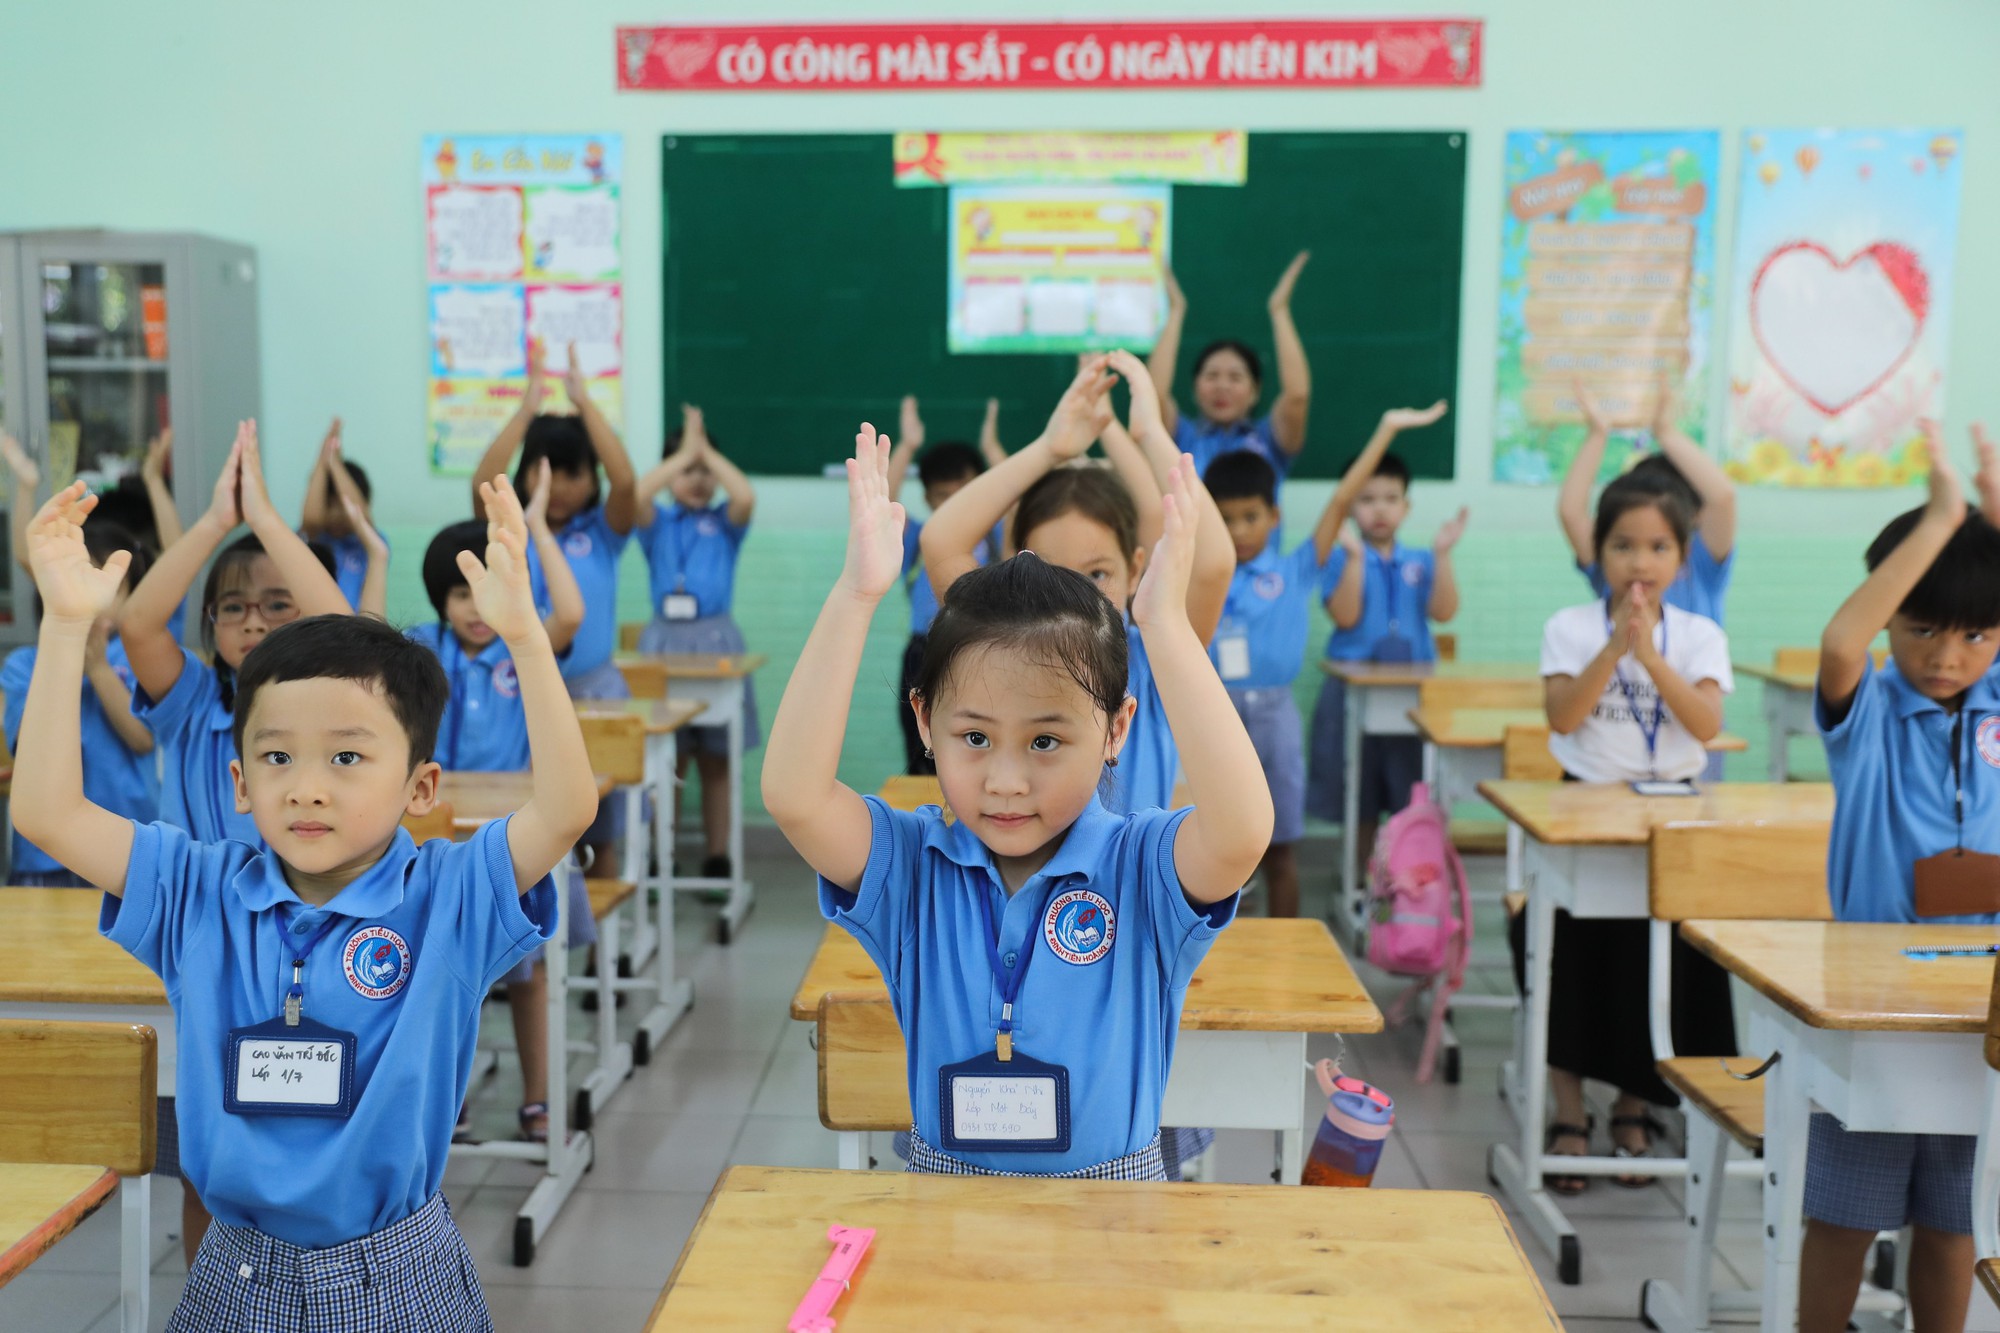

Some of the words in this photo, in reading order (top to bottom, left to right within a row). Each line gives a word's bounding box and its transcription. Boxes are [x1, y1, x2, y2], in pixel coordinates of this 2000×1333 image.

[717, 36, 766, 82] CÓ
[771, 36, 870, 82] CÔNG
[877, 35, 949, 81] MÀI
[955, 30, 1027, 81] SẮT
[1053, 33, 1104, 80] CÓ
[1109, 33, 1213, 80] NGÀY
[1218, 33, 1298, 80] NÊN
[1303, 39, 1378, 79] KIM
[252, 1049, 270, 1059] CAO
[272, 1045, 294, 1060] VĂN
[281, 1069, 303, 1084] 1/7
